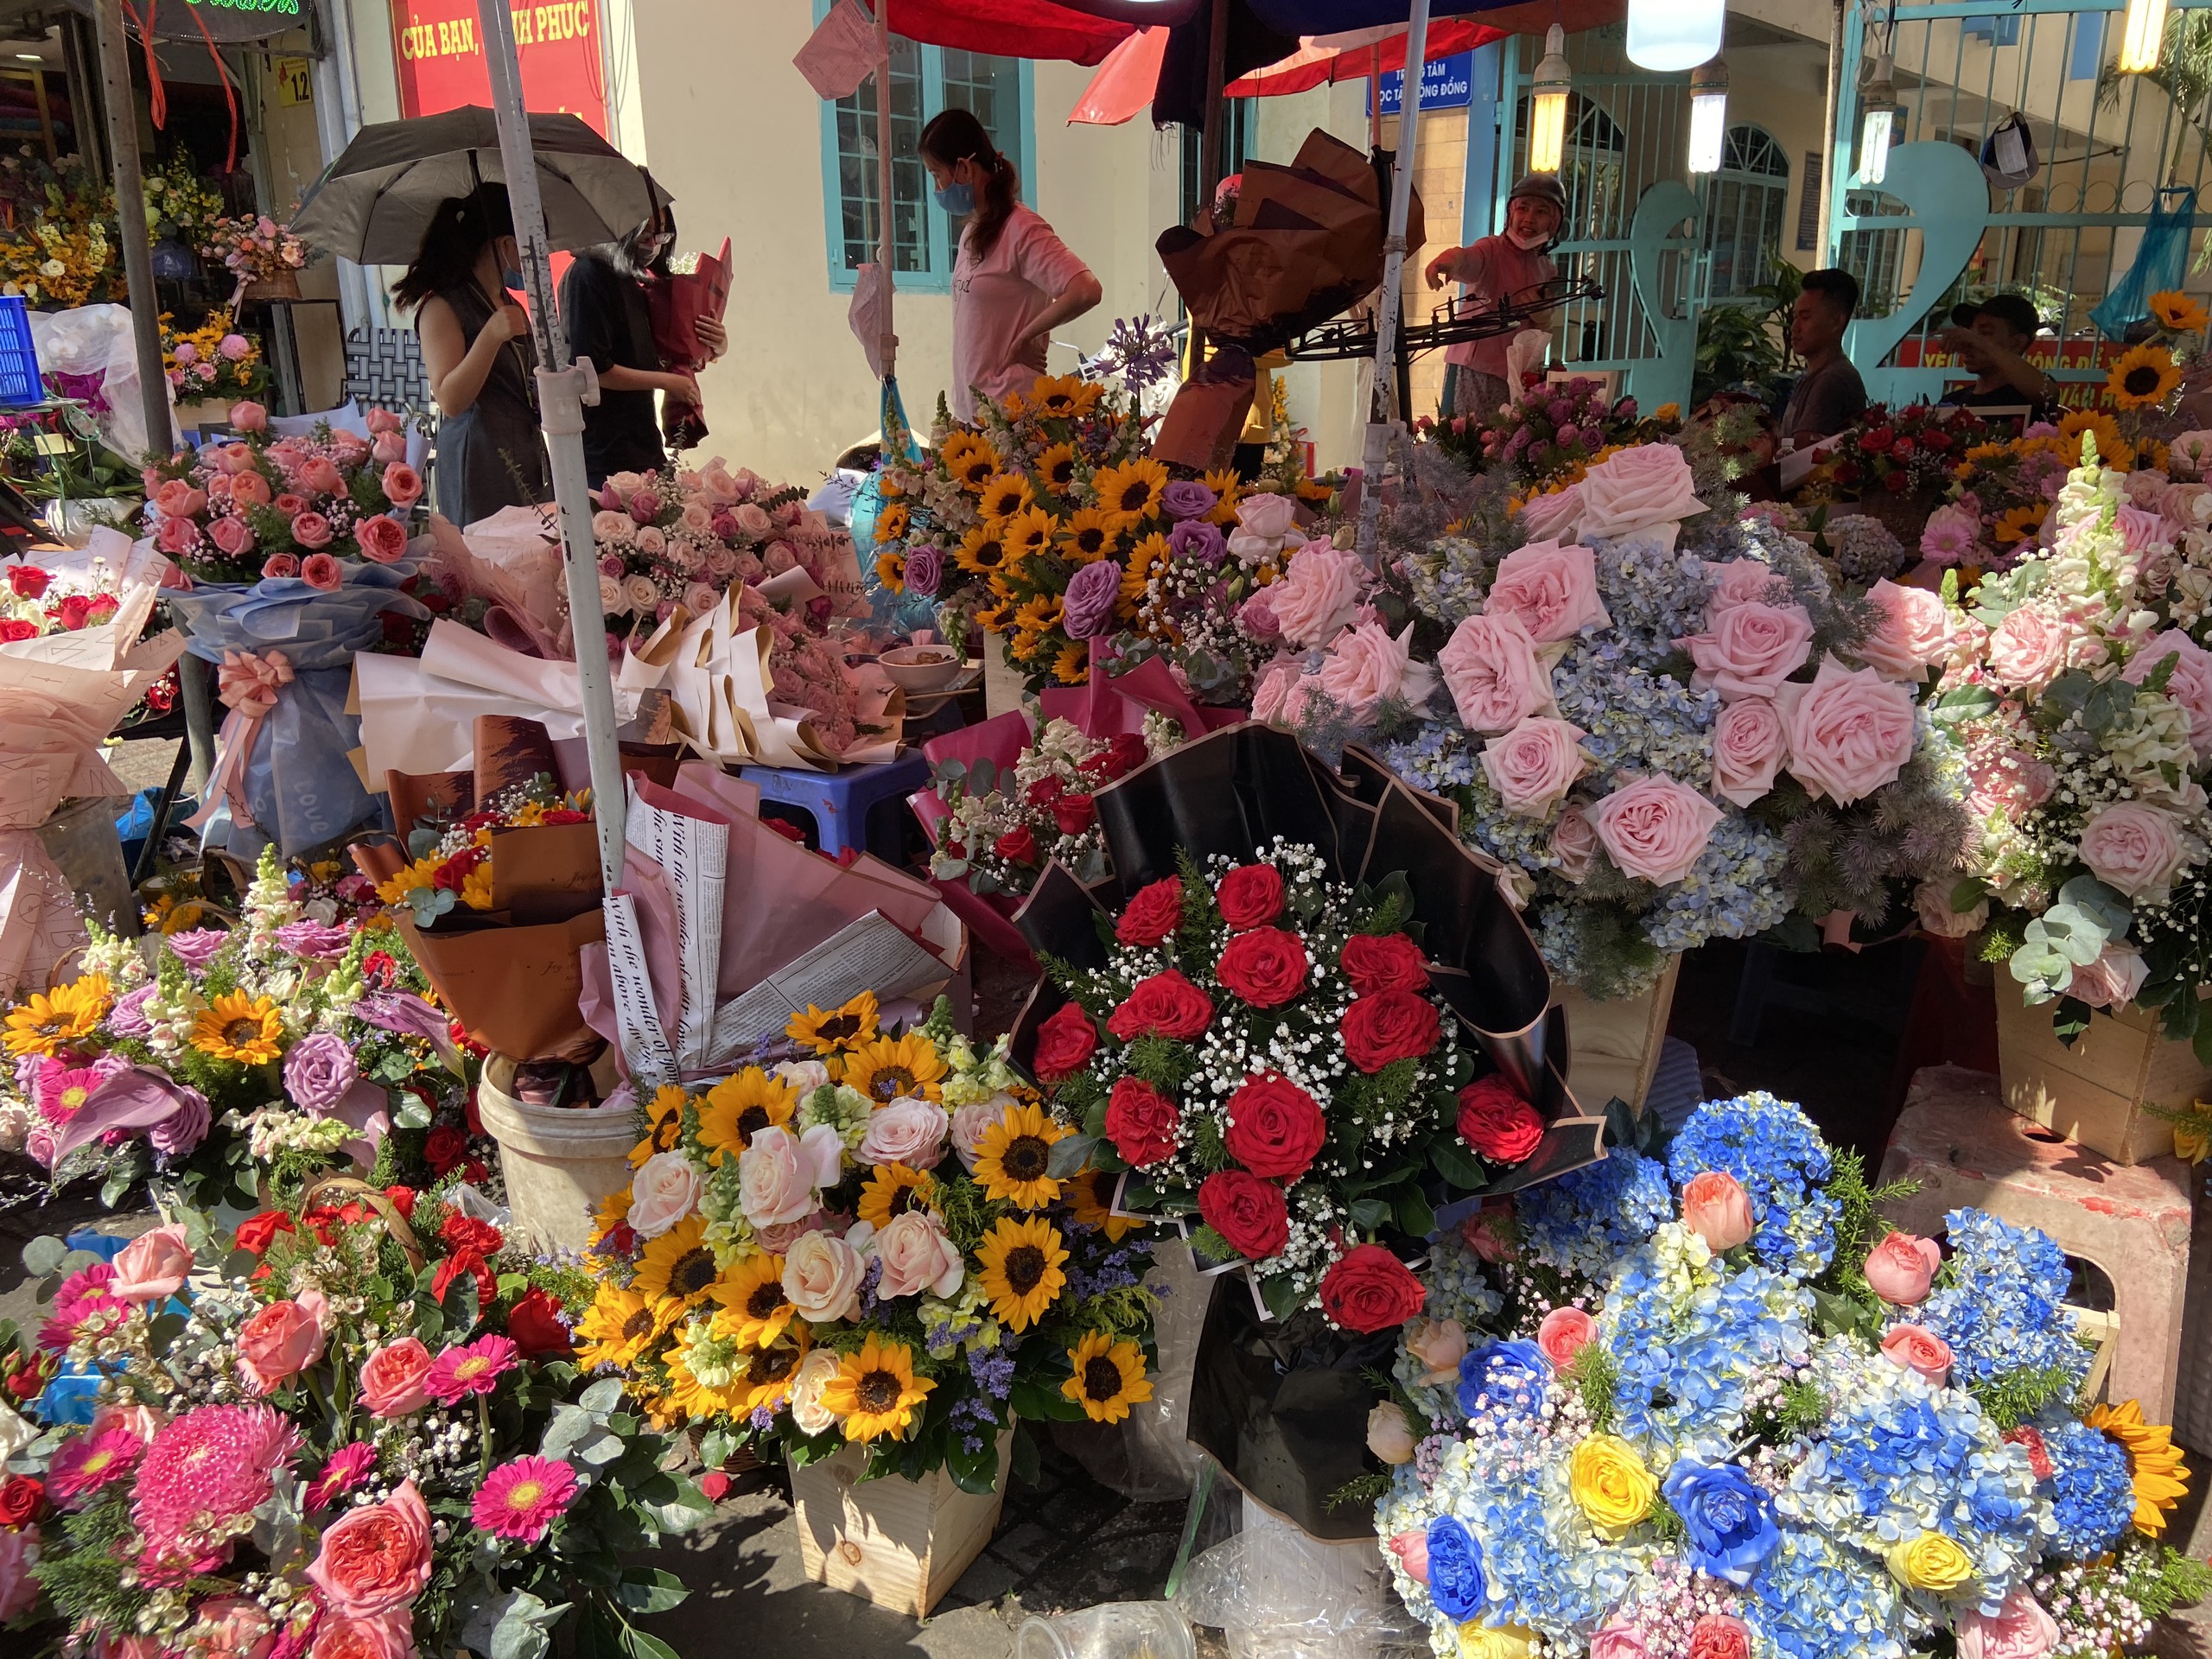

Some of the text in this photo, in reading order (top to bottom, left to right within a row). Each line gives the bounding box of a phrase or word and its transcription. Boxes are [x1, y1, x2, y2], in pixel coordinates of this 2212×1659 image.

[401, 14, 438, 60] CỦA
[440, 17, 480, 61] BẠN,
[1427, 61, 1446, 78] TÂM
[1380, 89, 1393, 105] ỌC
[1419, 83, 1439, 102] ỘNG
[1440, 76, 1467, 96] ĐỒNG
[673, 812, 689, 858] With
[674, 860, 689, 888] the
[609, 897, 633, 938] With
[623, 943, 640, 970] the
[632, 975, 662, 1036] wonder
[653, 1040, 672, 1055] of
[679, 957, 692, 980] of
[613, 963, 632, 1012] above
